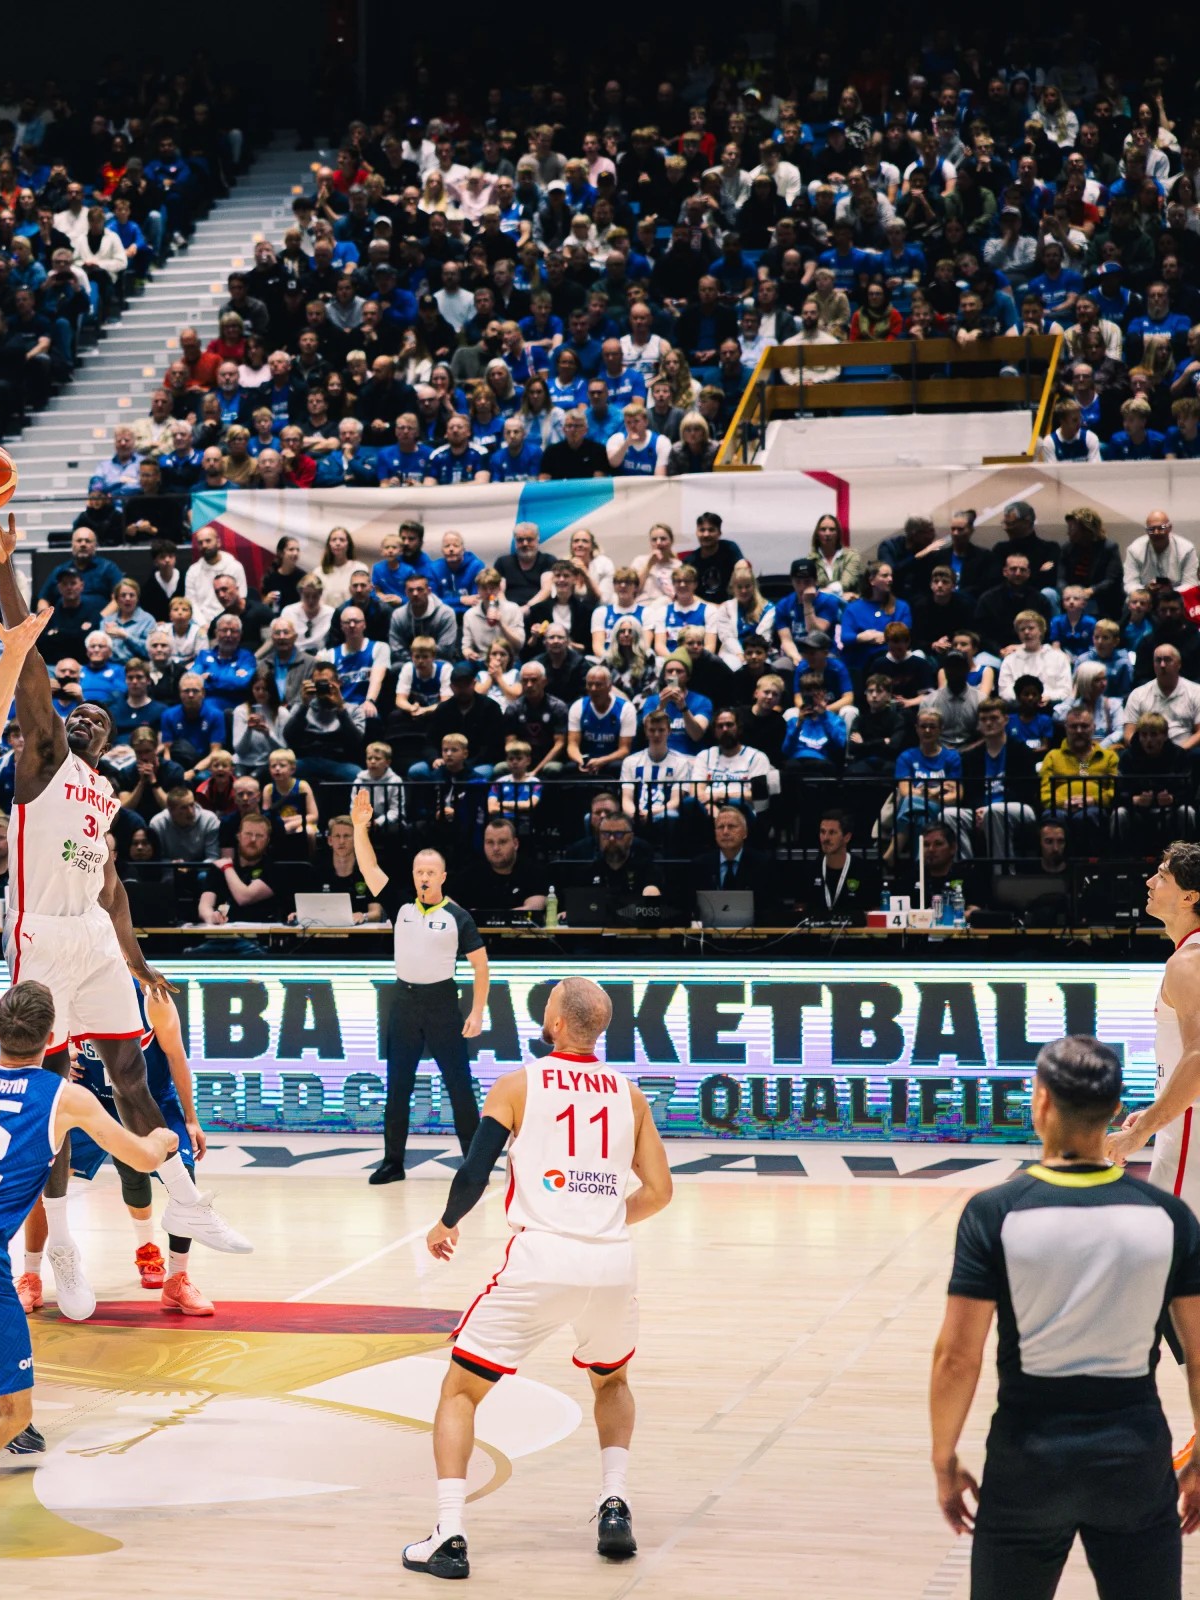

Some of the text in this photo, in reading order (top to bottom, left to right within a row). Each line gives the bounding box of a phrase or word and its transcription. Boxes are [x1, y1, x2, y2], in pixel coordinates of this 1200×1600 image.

[83, 814, 99, 842] 3
[370, 979, 1126, 1068] AKETBALL
[542, 1069, 618, 1094] FLYNN
[555, 1103, 609, 1160] 11
